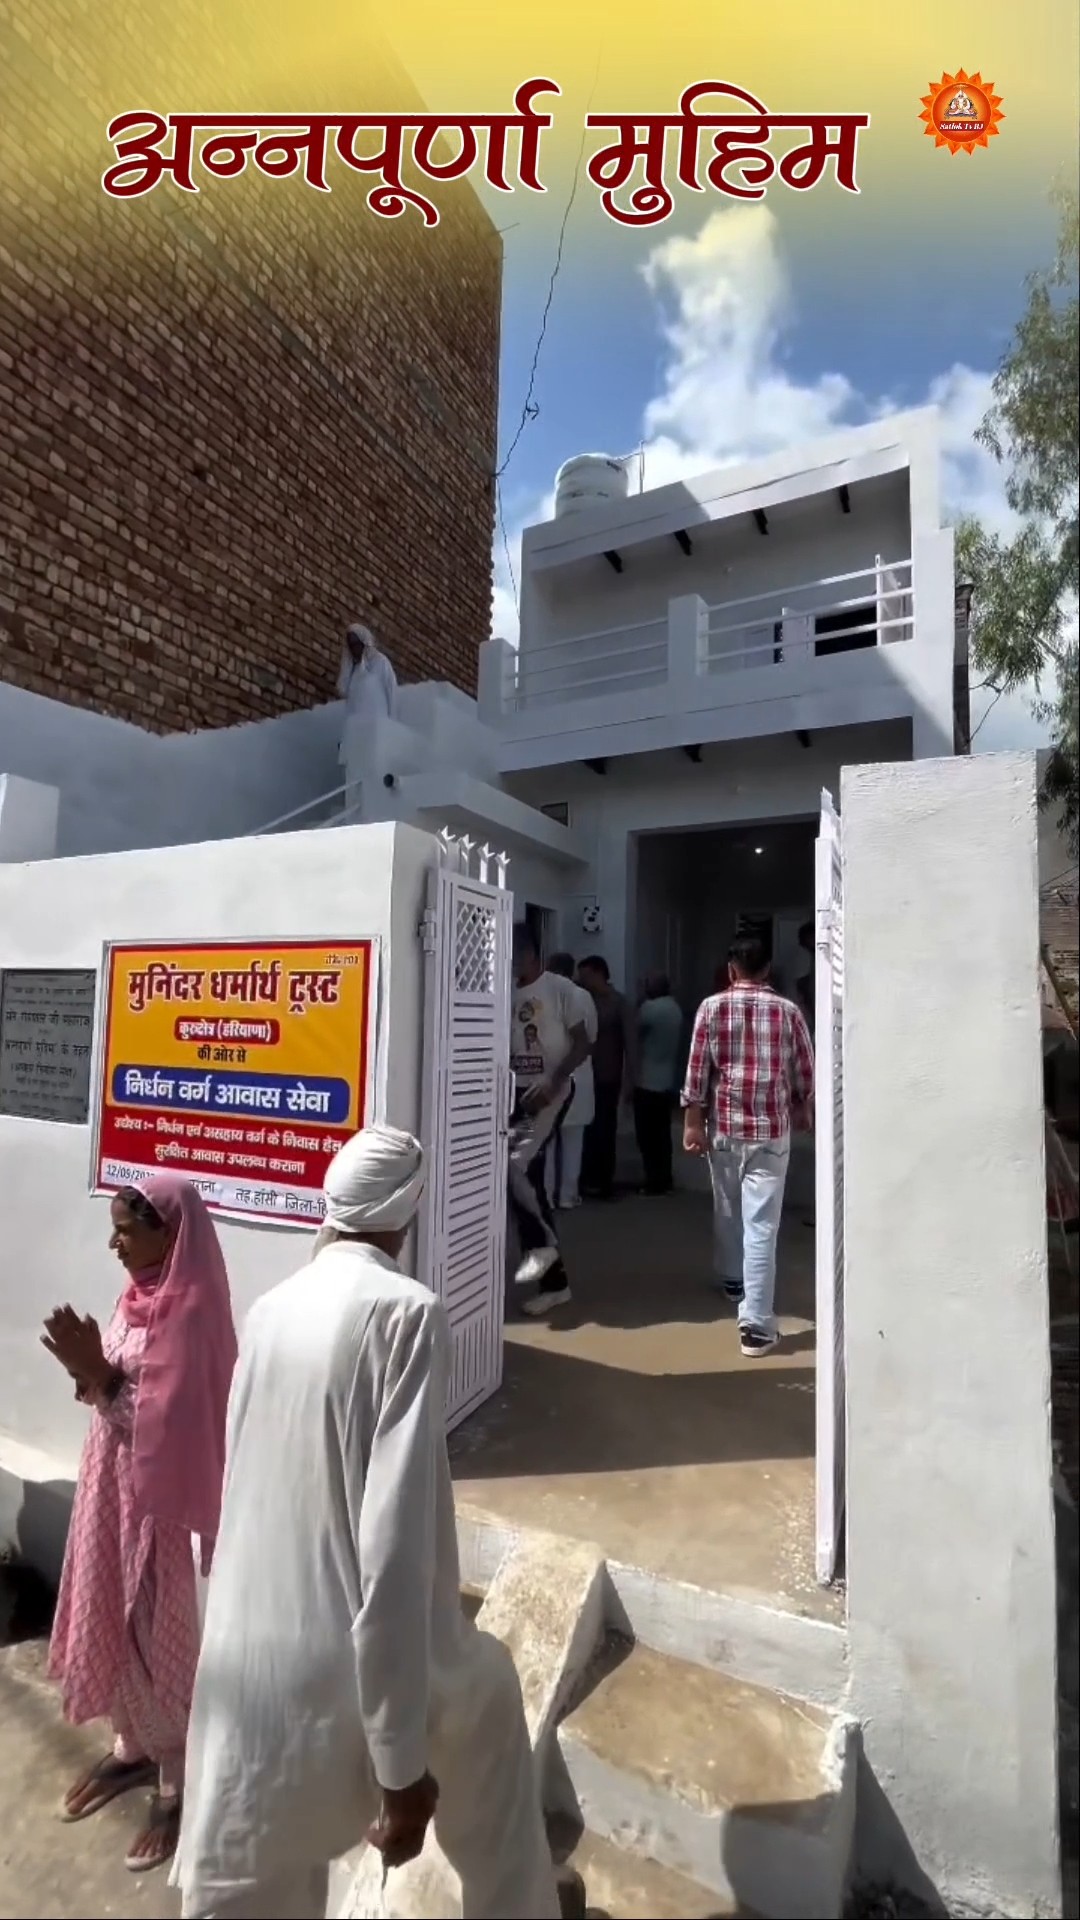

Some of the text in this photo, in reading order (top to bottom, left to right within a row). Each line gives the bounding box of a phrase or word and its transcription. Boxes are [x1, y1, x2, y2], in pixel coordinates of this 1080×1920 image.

[128, 960, 341, 1013] मुनिंदर धर्मार्थ ट्रस्ट
[197, 1044, 247, 1063] की ओर से
[124, 1069, 331, 1113] निर्धन वर्ग आवास सेवा
